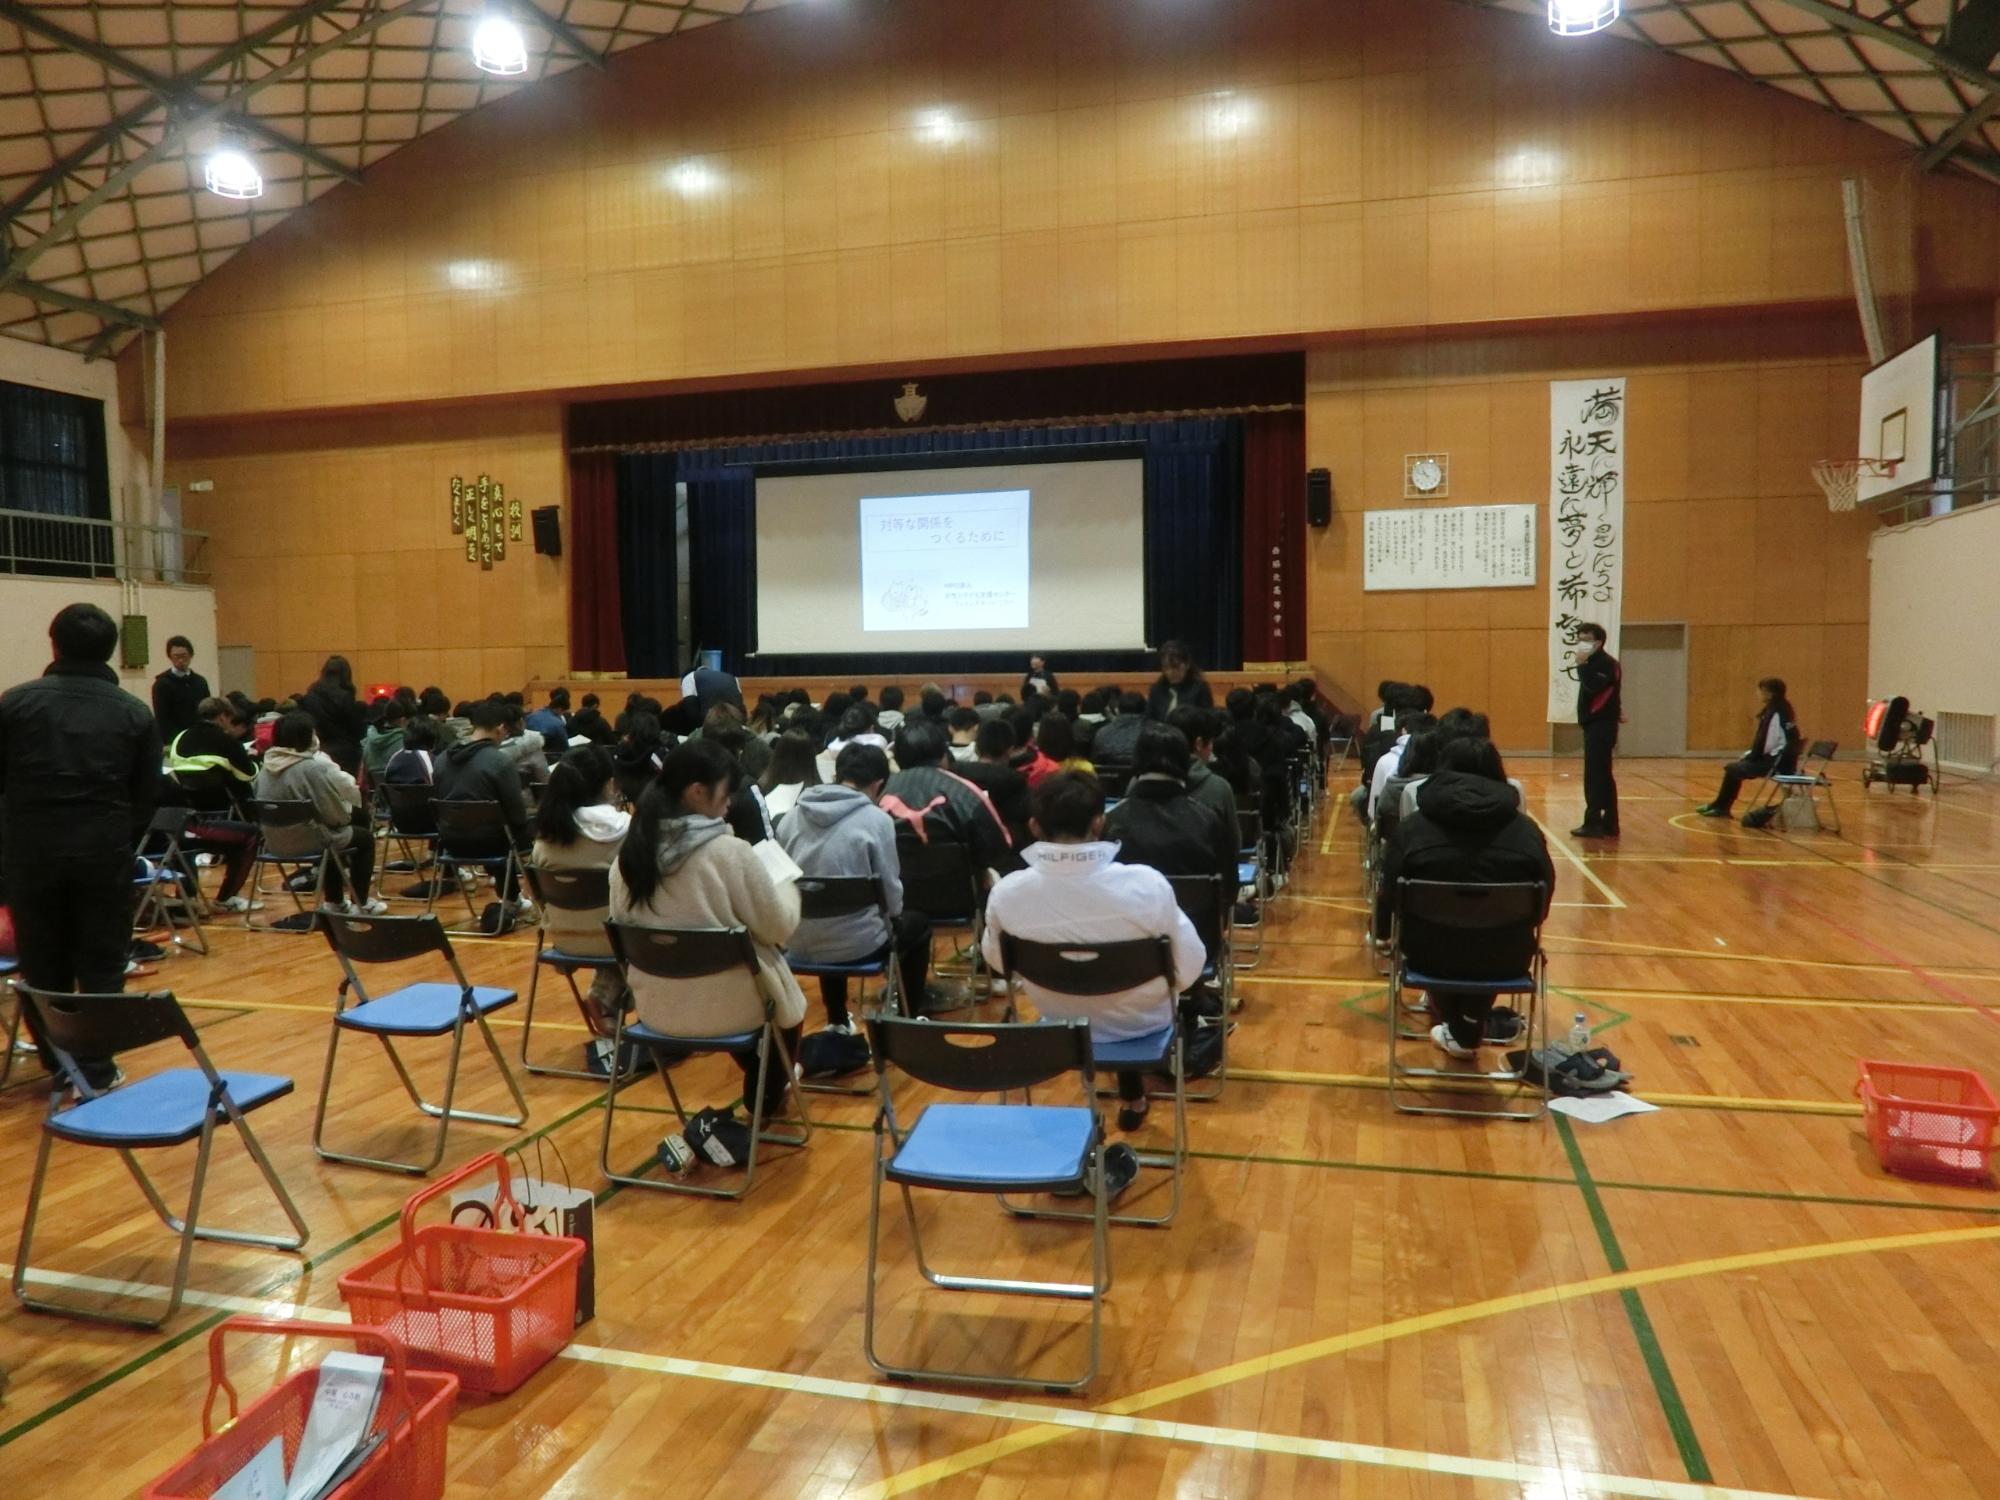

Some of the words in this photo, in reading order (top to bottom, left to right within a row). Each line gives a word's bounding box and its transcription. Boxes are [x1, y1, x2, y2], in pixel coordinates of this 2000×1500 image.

[510, 501, 522, 539] 校訓
[880, 516, 953, 532] 対等な関係を
[930, 530, 1006, 544] つくるために
[1038, 850, 1107, 862] HILFIGER
